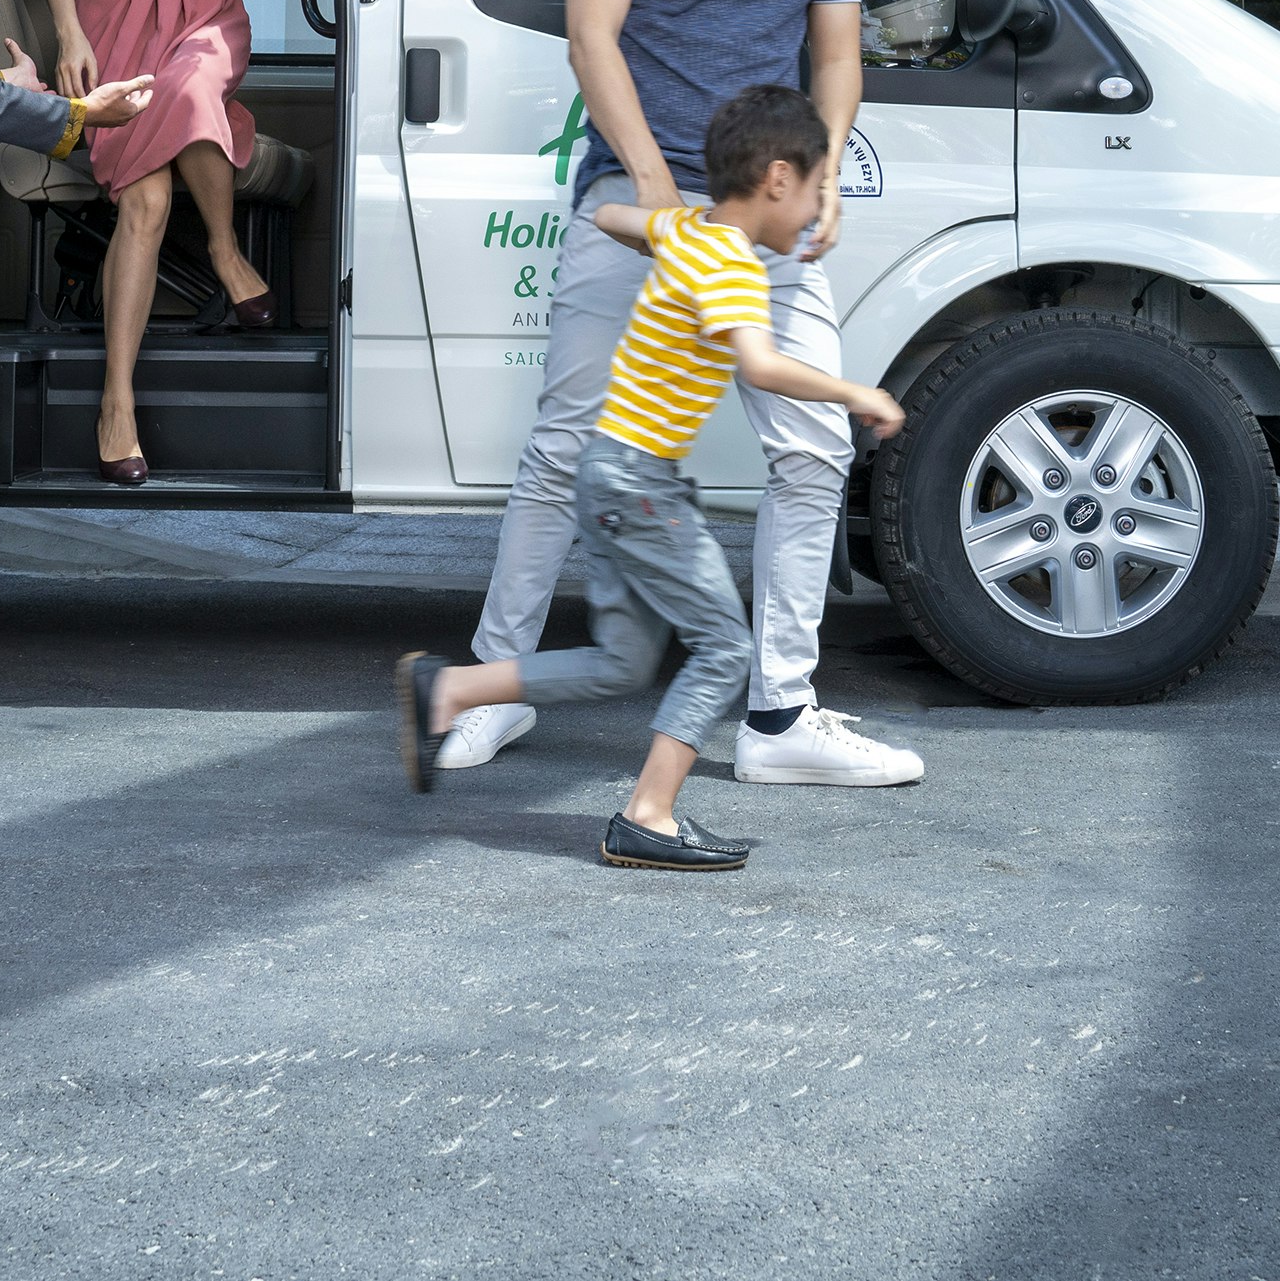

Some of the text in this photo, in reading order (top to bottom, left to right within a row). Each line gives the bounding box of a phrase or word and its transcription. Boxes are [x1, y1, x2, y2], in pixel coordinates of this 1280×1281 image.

[1105, 136, 1132, 150] LX
[861, 163, 873, 183] EZY
[483, 210, 568, 249] Holi
[513, 265, 539, 298] &
[512, 312, 538, 327] AN
[504, 351, 548, 366] SAIG
